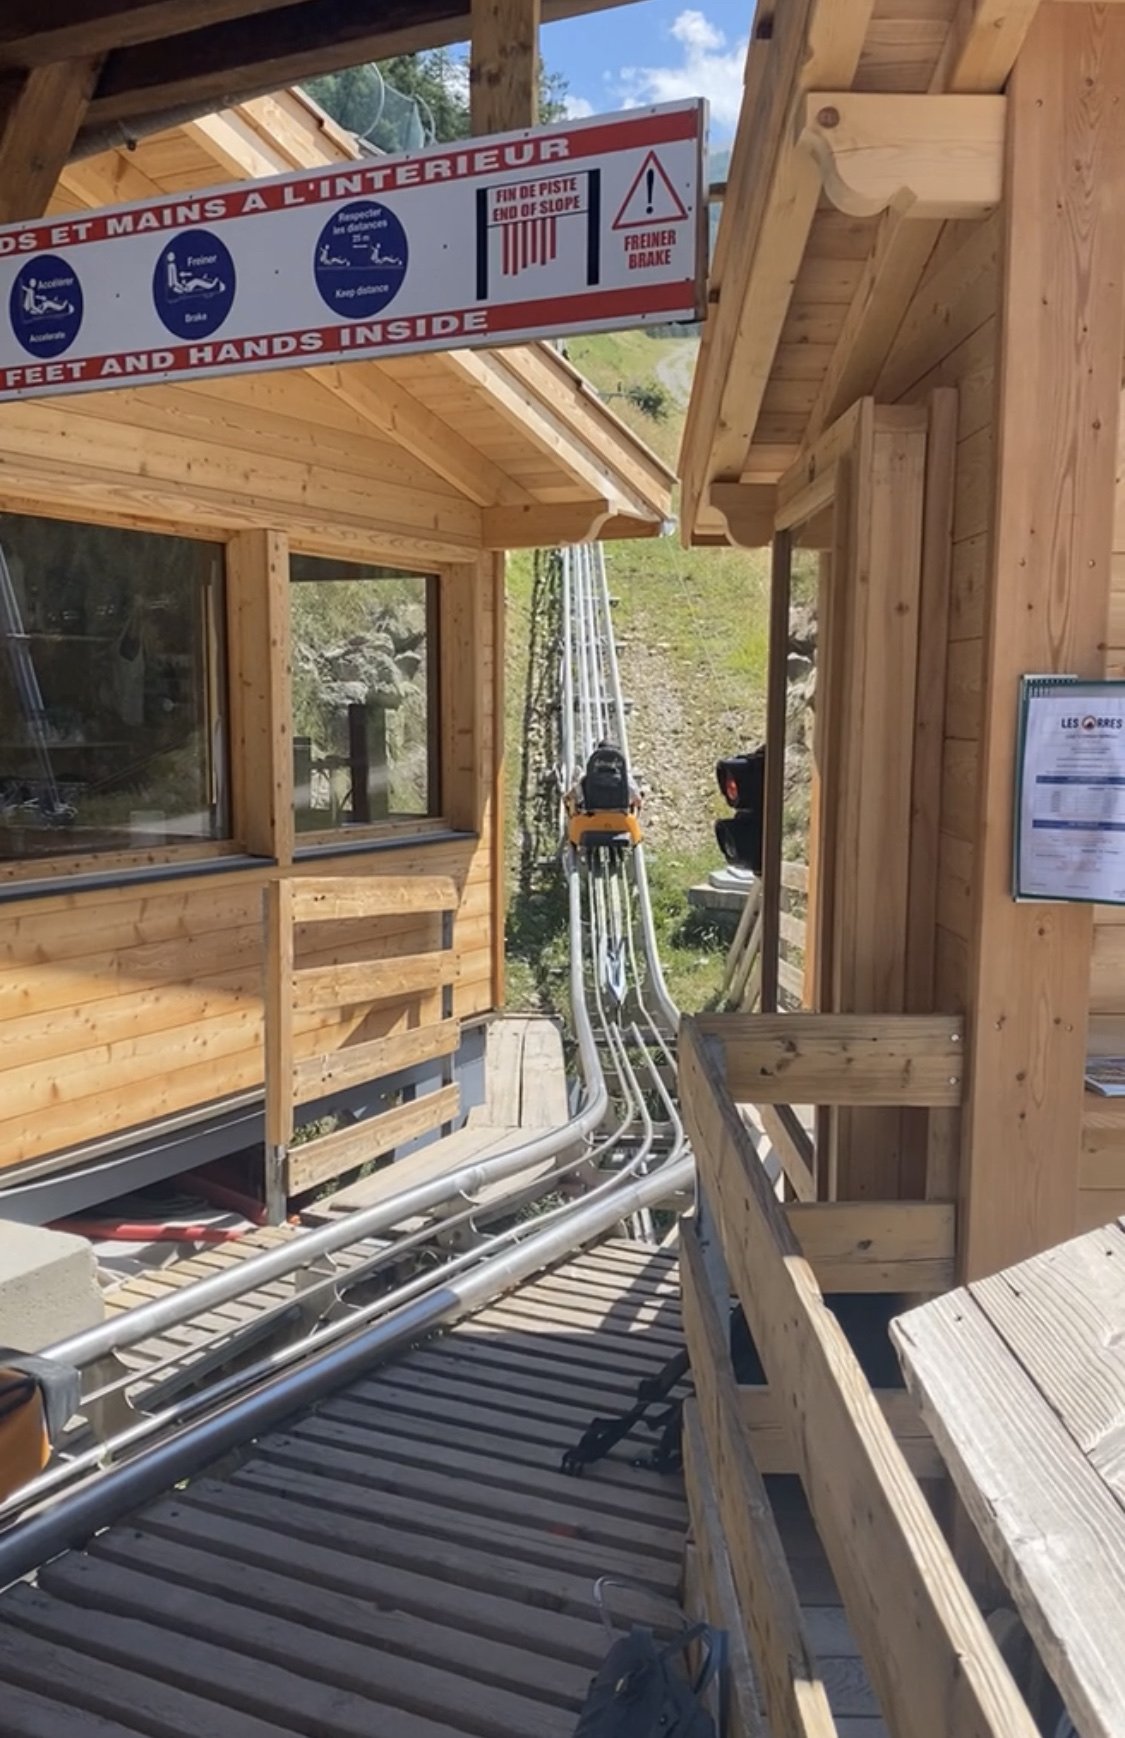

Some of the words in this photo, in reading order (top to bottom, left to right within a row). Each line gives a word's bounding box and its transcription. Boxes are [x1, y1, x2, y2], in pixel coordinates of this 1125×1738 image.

[0, 232, 37, 254] DS
[51, 223, 93, 245] ET
[106, 198, 227, 236] MAINS
[242, 193, 268, 212] A
[284, 137, 570, 204] L'INTERIEUR
[496, 187, 517, 203] FIN
[519, 184, 536, 199] DE
[538, 177, 577, 196] PISTE
[338, 208, 382, 223] Respecter
[493, 205, 518, 222] END
[521, 202, 537, 217] OF
[540, 195, 581, 214] SLOPE
[348, 220, 389, 233] distances
[624, 229, 677, 251] FREINER
[187, 254, 218, 267] Freiner
[628, 249, 672, 270] BRAKE
[335, 288, 355, 298] Keep
[356, 283, 390, 297] distance
[184, 312, 208, 324] Brake
[6, 361, 86, 387] FEET
[100, 351, 174, 376] AND
[189, 332, 324, 364] HANDS
[339, 310, 488, 346] INSIDE
[1061, 717, 1080, 729] LES
